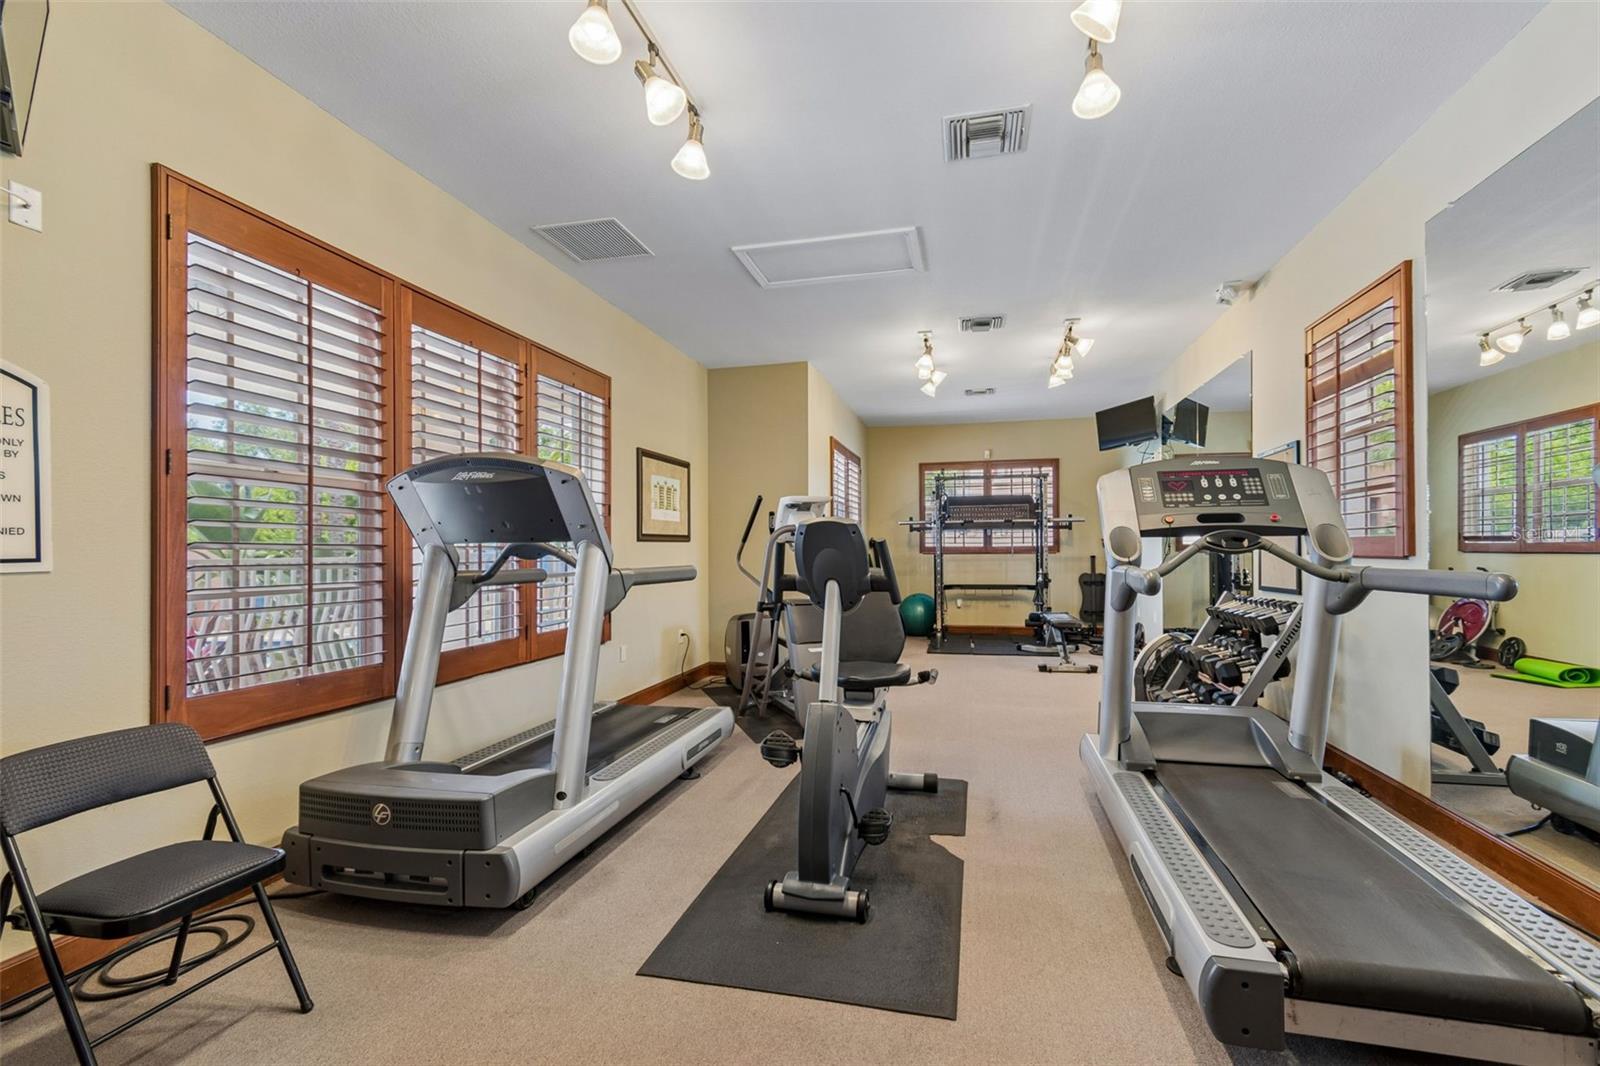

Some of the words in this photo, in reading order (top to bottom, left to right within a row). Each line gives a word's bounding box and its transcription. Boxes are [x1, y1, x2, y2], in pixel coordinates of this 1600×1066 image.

[0, 405, 25, 427] ES
[0, 437, 24, 447] NLY
[4, 449, 19, 459] BY
